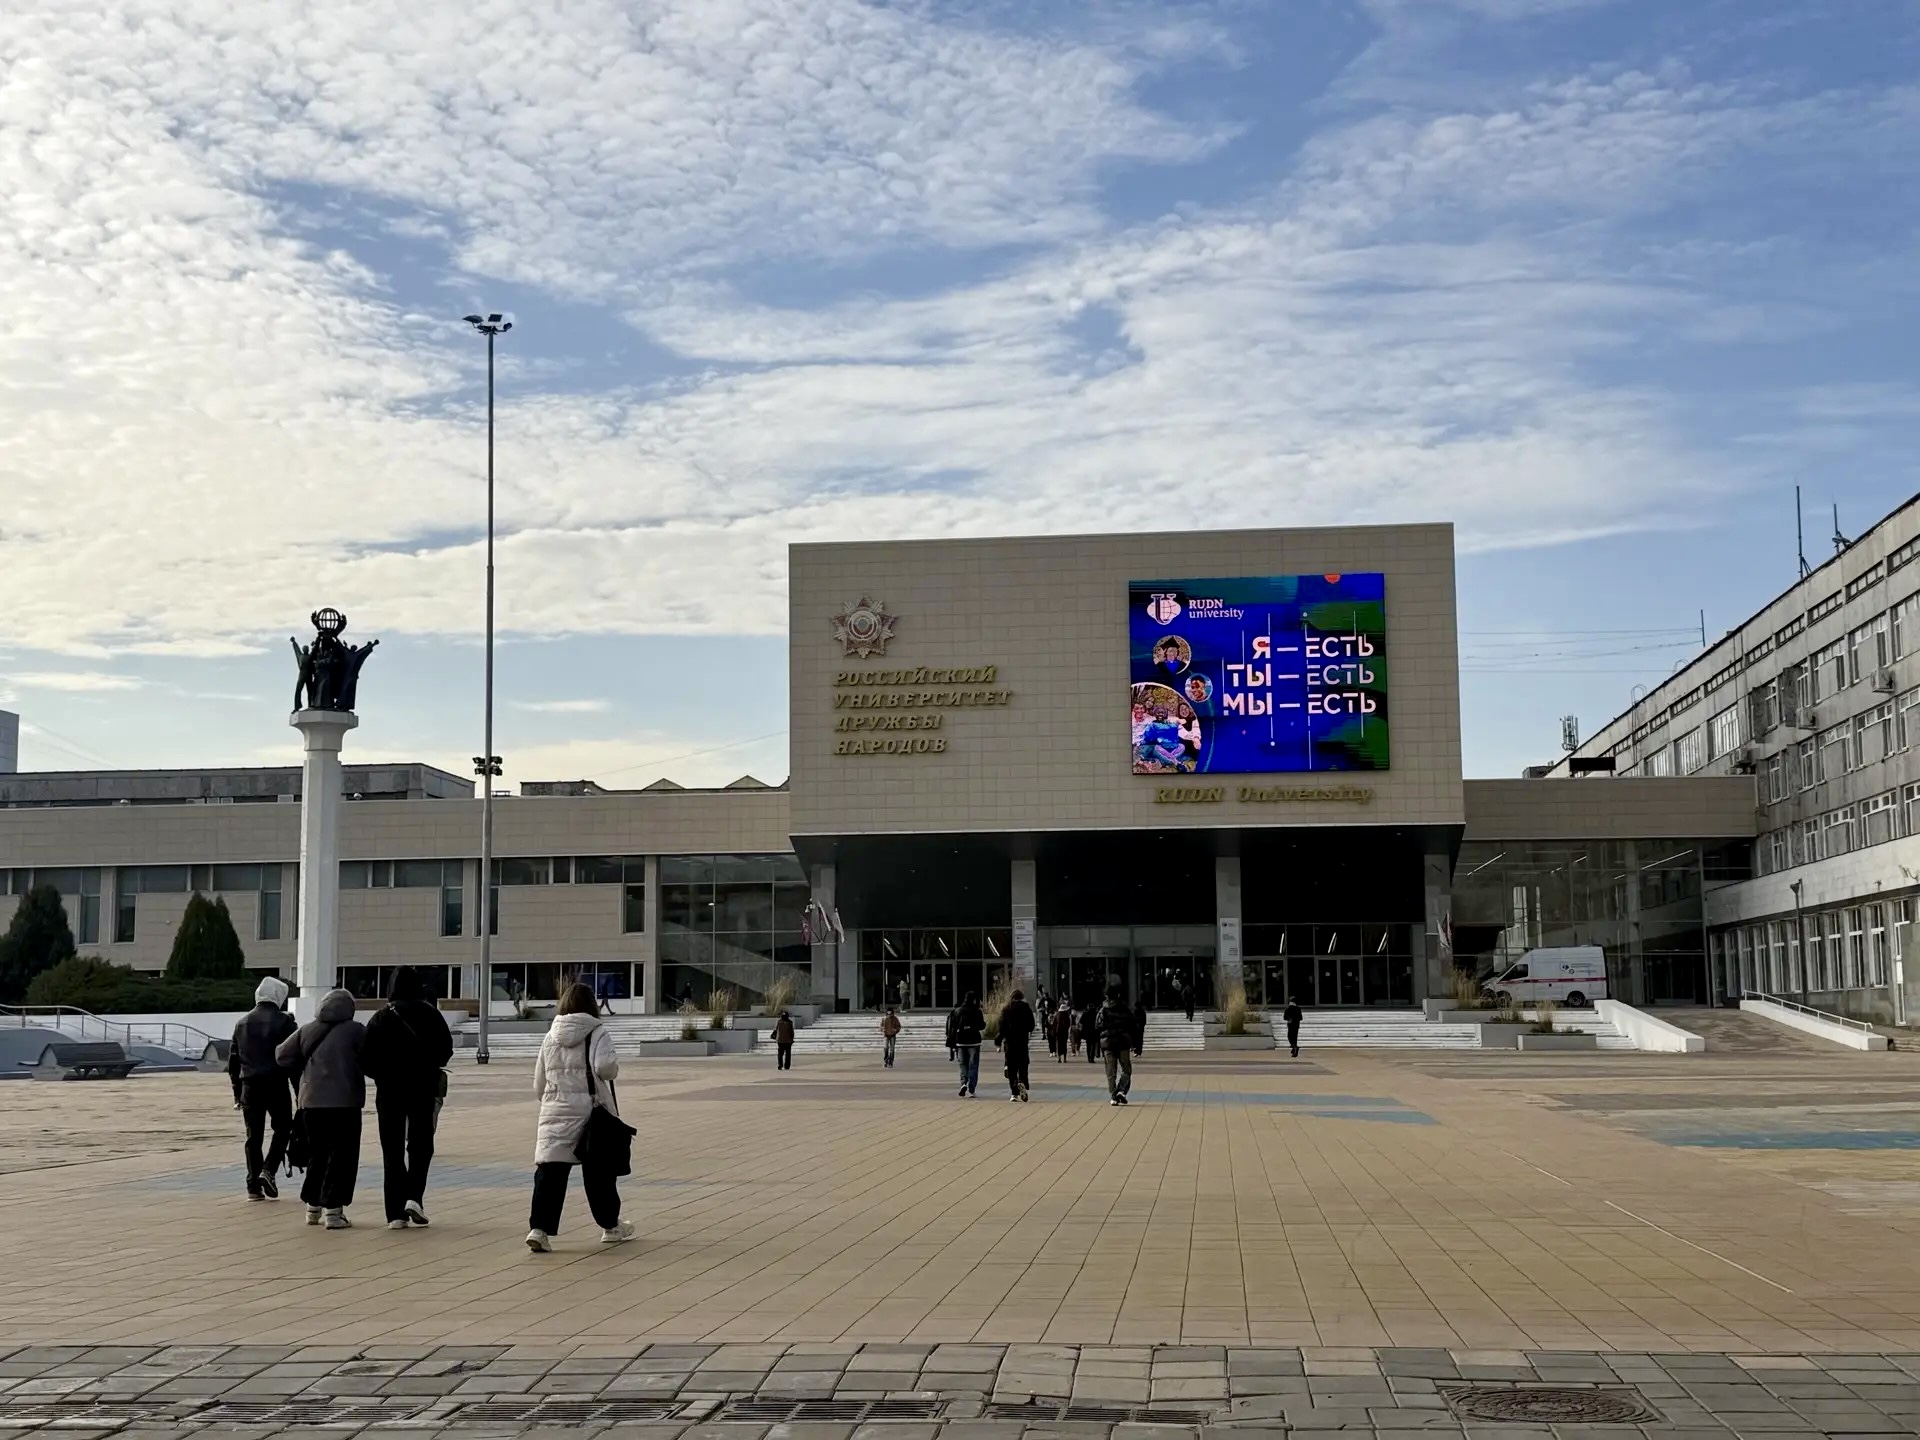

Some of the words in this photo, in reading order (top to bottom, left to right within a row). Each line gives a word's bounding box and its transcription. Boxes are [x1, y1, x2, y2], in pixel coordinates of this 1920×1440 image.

[1189, 599, 1223, 609] RUDN
[1189, 608, 1244, 620] university
[1252, 636, 1271, 659] Я
[1305, 635, 1374, 657] ЕСТЬ
[833, 665, 997, 686] РОССИЙСКИЙ
[1227, 664, 1271, 687] ТЫ
[1306, 664, 1375, 685] ЕСТЬ
[834, 690, 1012, 709] УНИВЕРСИТЕТ
[1223, 692, 1273, 716] МЫ
[1307, 692, 1377, 714] ЕСТЬ
[834, 714, 943, 732] ДРУЖБЫ
[834, 738, 946, 755] НАРОДОВ
[1237, 786, 1374, 805] University
